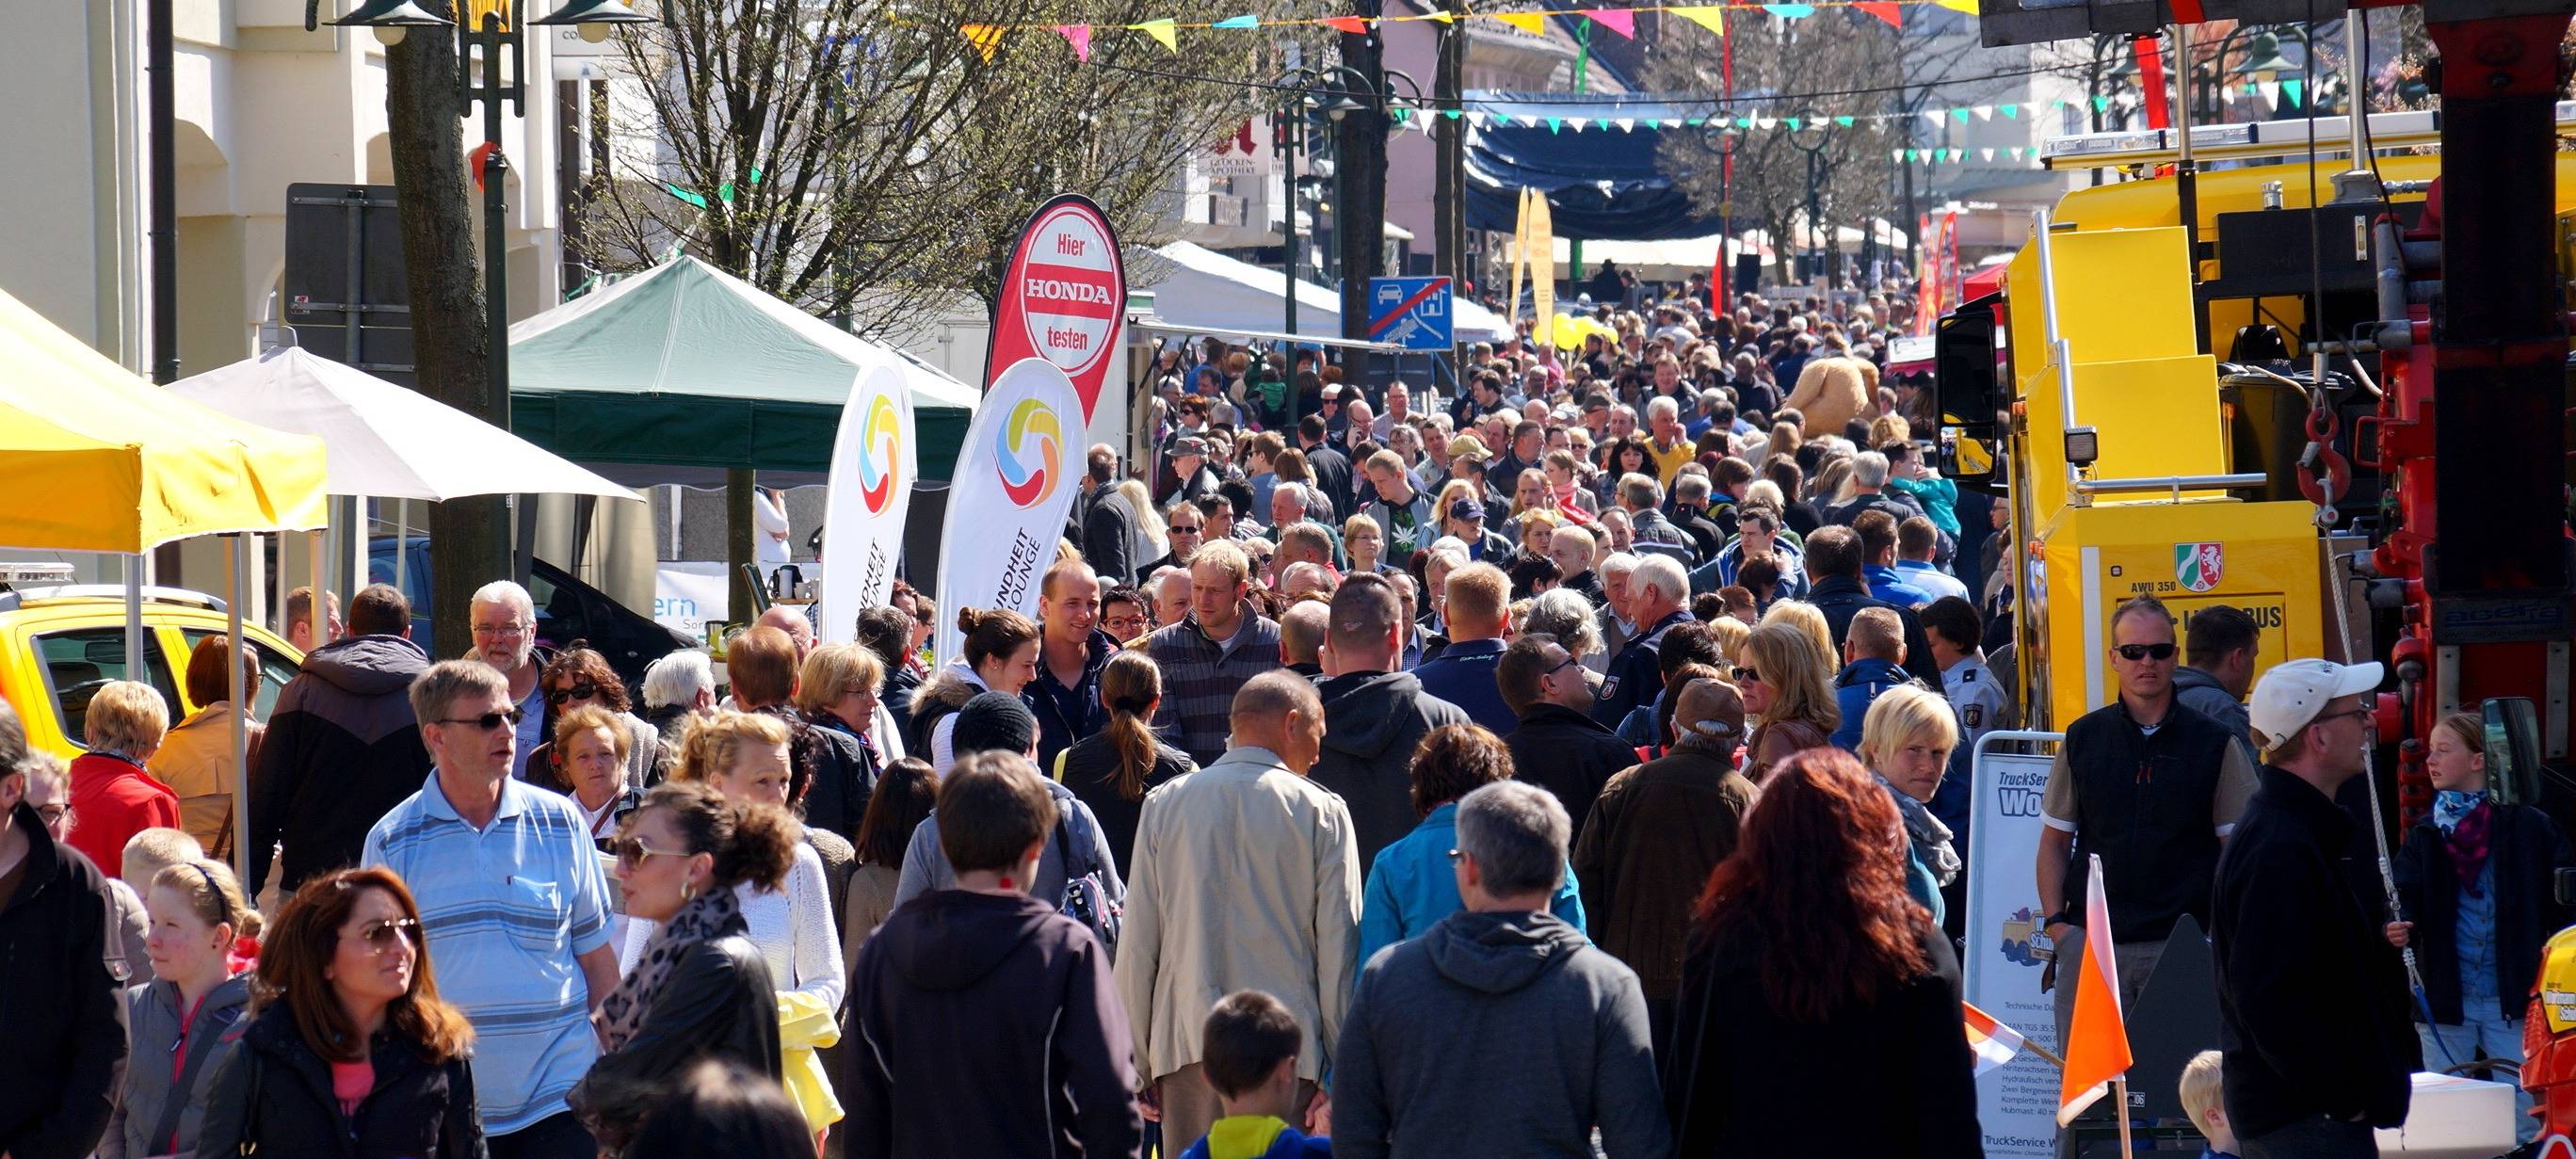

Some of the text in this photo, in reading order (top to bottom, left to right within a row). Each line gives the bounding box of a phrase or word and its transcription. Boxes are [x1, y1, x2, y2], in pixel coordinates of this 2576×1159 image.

[1056, 233, 1086, 257] Hier
[1026, 278, 1112, 305] HONDA
[1047, 326, 1088, 350] testen
[1007, 537, 1040, 612] LOUNGE
[2131, 581, 2177, 593] AWU 350
[654, 597, 696, 617] ern
[684, 619, 706, 630] Sor
[1999, 771, 2049, 787] TruckSer
[1998, 787, 2044, 817] Wo
[2004, 1001, 2055, 1011] Technische Da
[2024, 1023, 2038, 1032] TGS
[2037, 1034, 2053, 1042] 500
[2003, 1065, 2050, 1073] Hinterachsen
[2002, 1075, 2043, 1084] Hydraulisch
[2001, 1096, 2040, 1104] Komplette
[2037, 1107, 2048, 1116] 40
[1984, 1135, 2056, 1149] TruckService W
